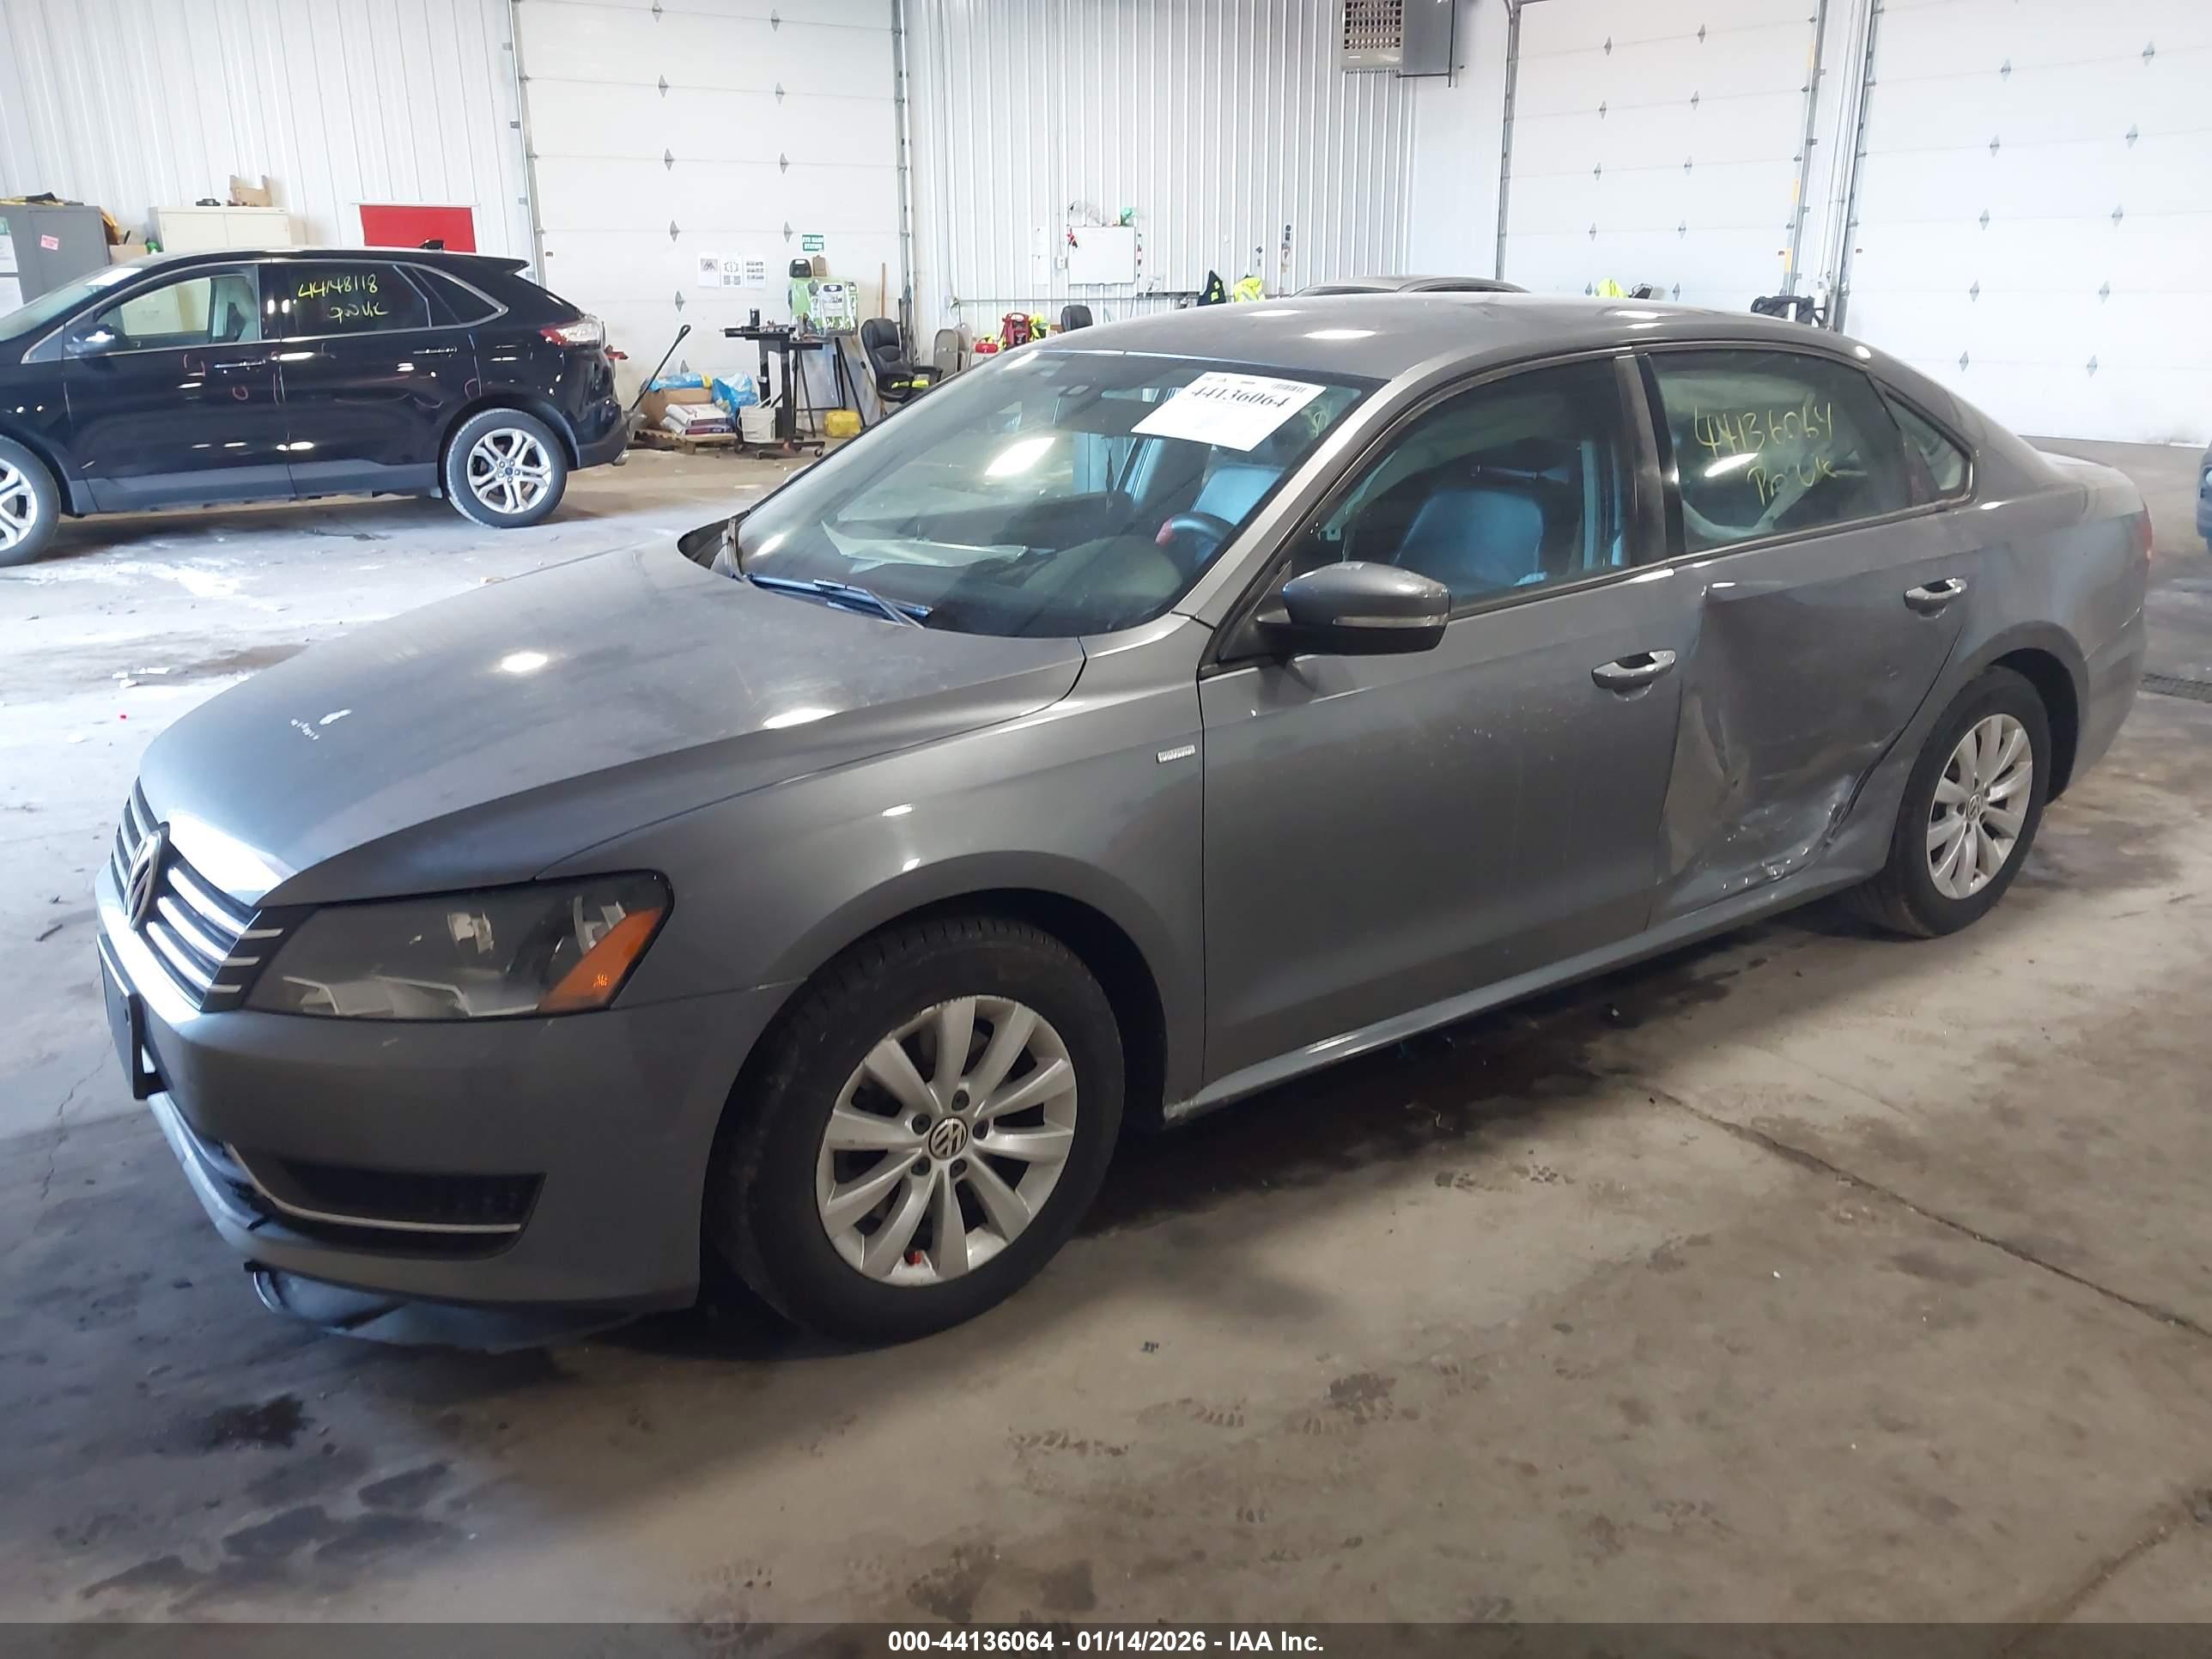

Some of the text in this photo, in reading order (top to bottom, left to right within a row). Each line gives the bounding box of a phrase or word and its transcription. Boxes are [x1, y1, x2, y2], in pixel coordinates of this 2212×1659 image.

[297, 273, 379, 299] 44148118
[1191, 386, 1291, 408] 44136064
[1693, 402, 1833, 459] 44136064
